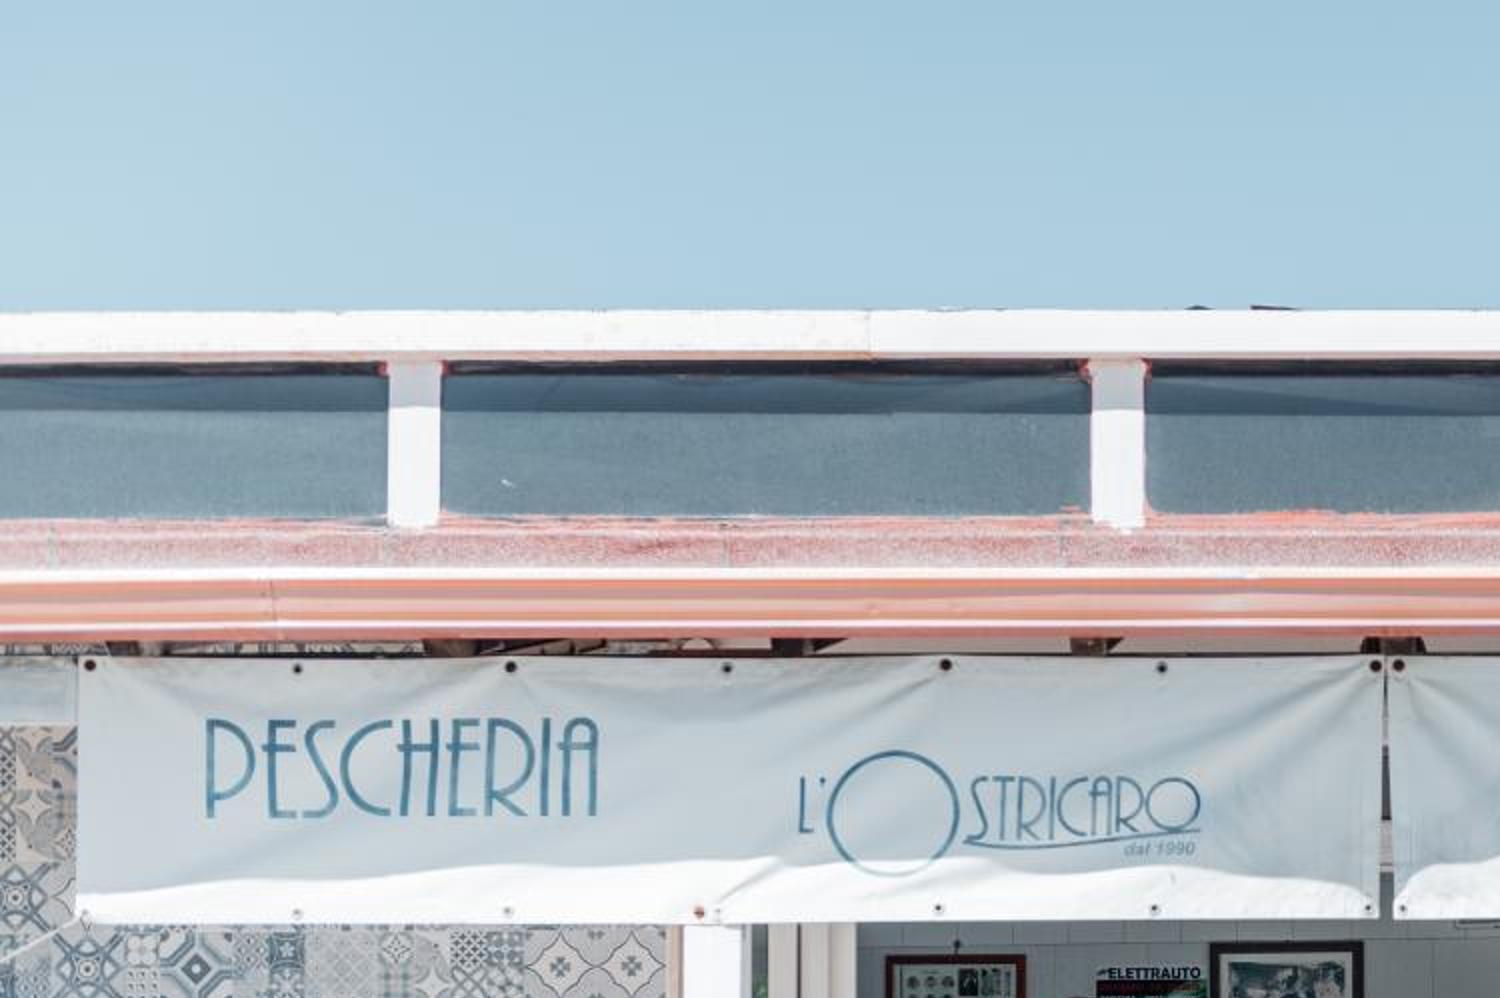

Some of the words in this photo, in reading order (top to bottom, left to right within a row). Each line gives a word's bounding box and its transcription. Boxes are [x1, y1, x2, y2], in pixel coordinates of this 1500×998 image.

[205, 717, 599, 819] PESCHERIA
[1123, 842, 1151, 857] dal
[1157, 841, 1196, 857] 1990
[1108, 967, 1201, 979] ELETTRAUTO
